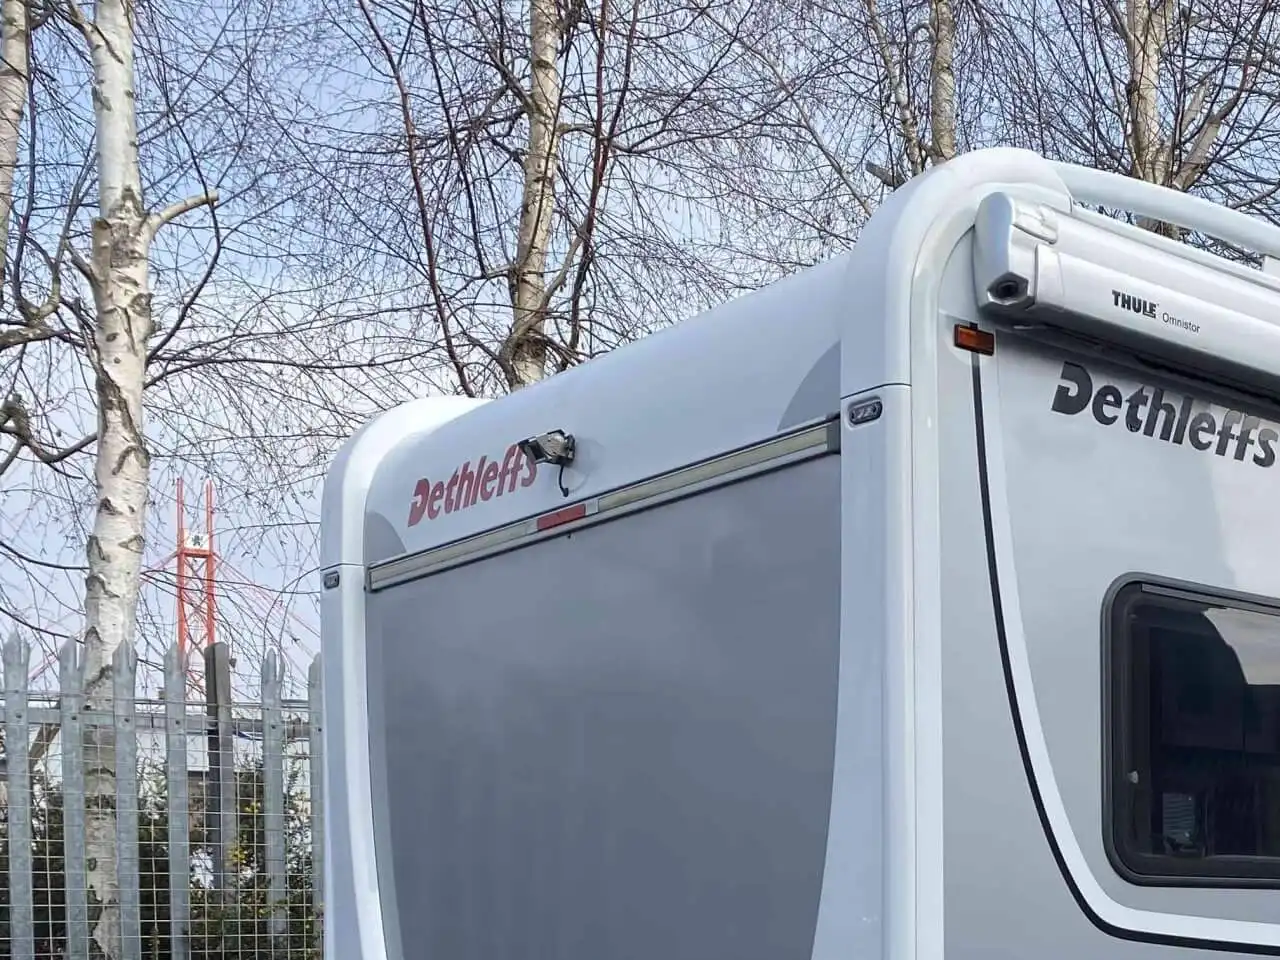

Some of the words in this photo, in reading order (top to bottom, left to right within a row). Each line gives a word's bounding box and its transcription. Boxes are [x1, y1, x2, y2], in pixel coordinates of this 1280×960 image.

[1112, 289, 1157, 318] THULE
[1162, 312, 1200, 333] Omnistor
[1051, 360, 1279, 468] Dethleffs
